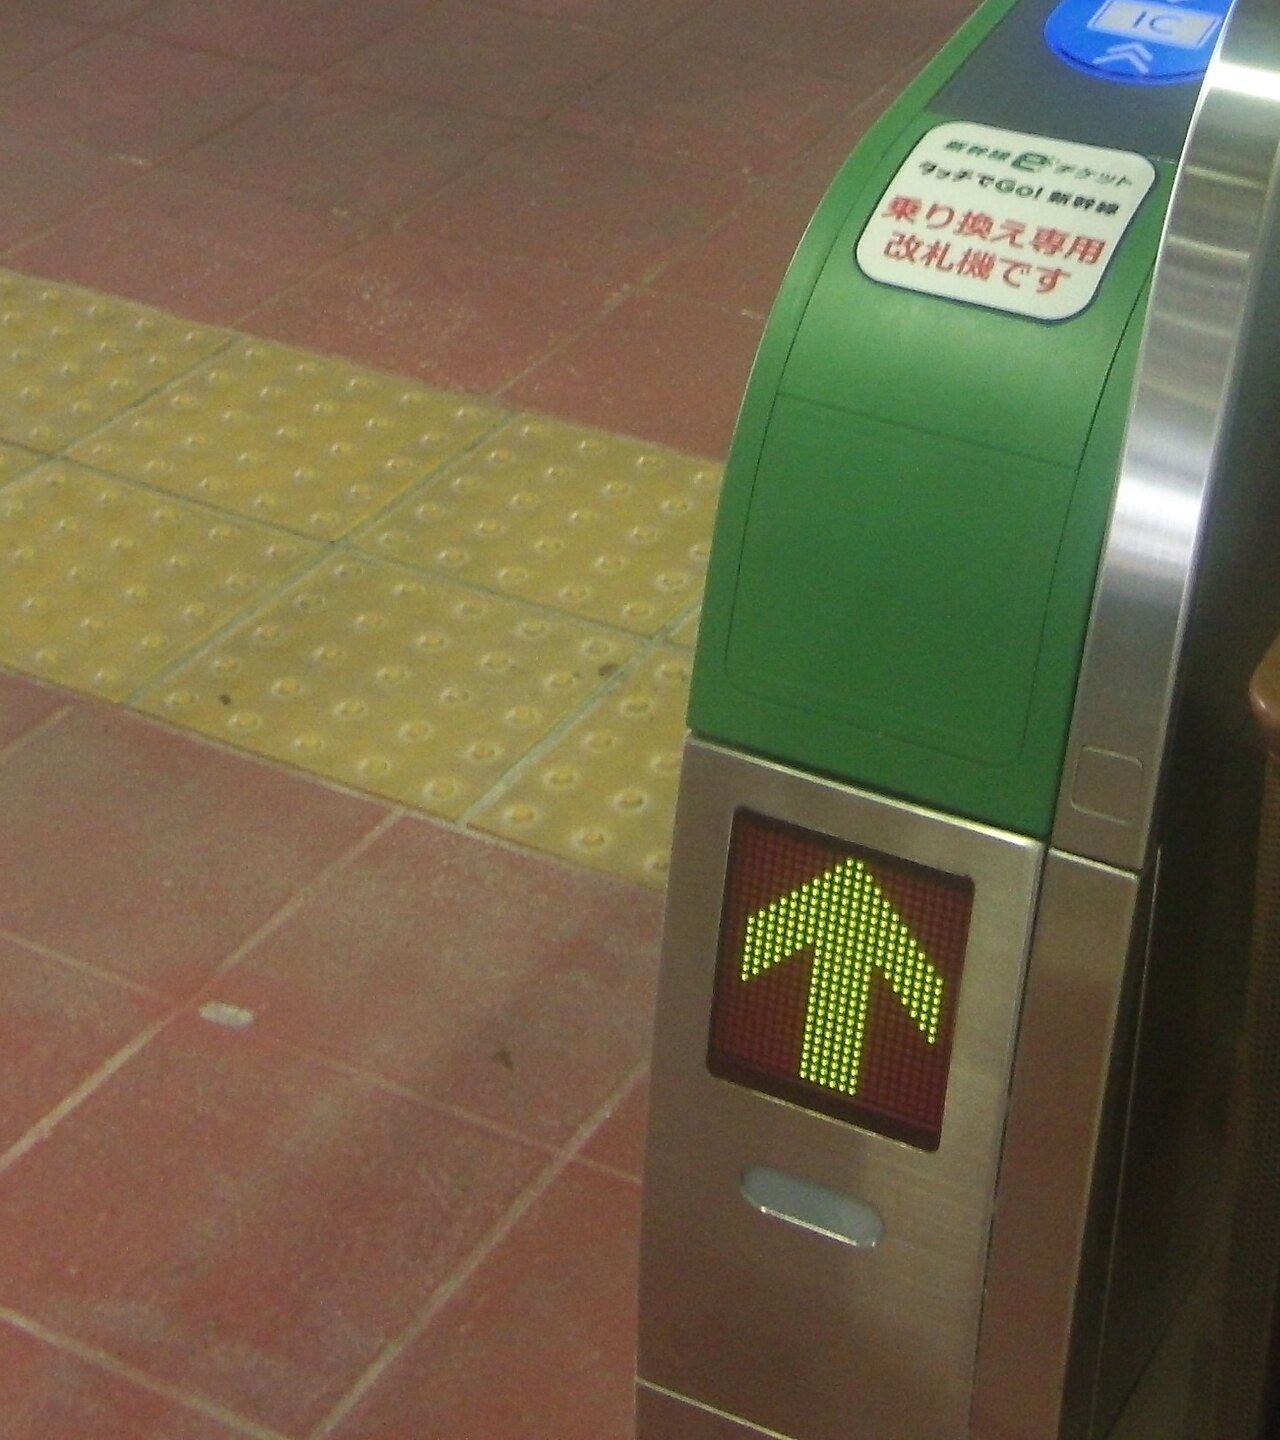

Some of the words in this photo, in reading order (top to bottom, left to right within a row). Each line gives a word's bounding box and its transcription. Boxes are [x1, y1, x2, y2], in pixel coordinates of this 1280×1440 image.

[1133, 10, 1182, 35] IC
[881, 195, 1107, 265] 乗り換え専用
[882, 230, 1072, 294] 改札機です
